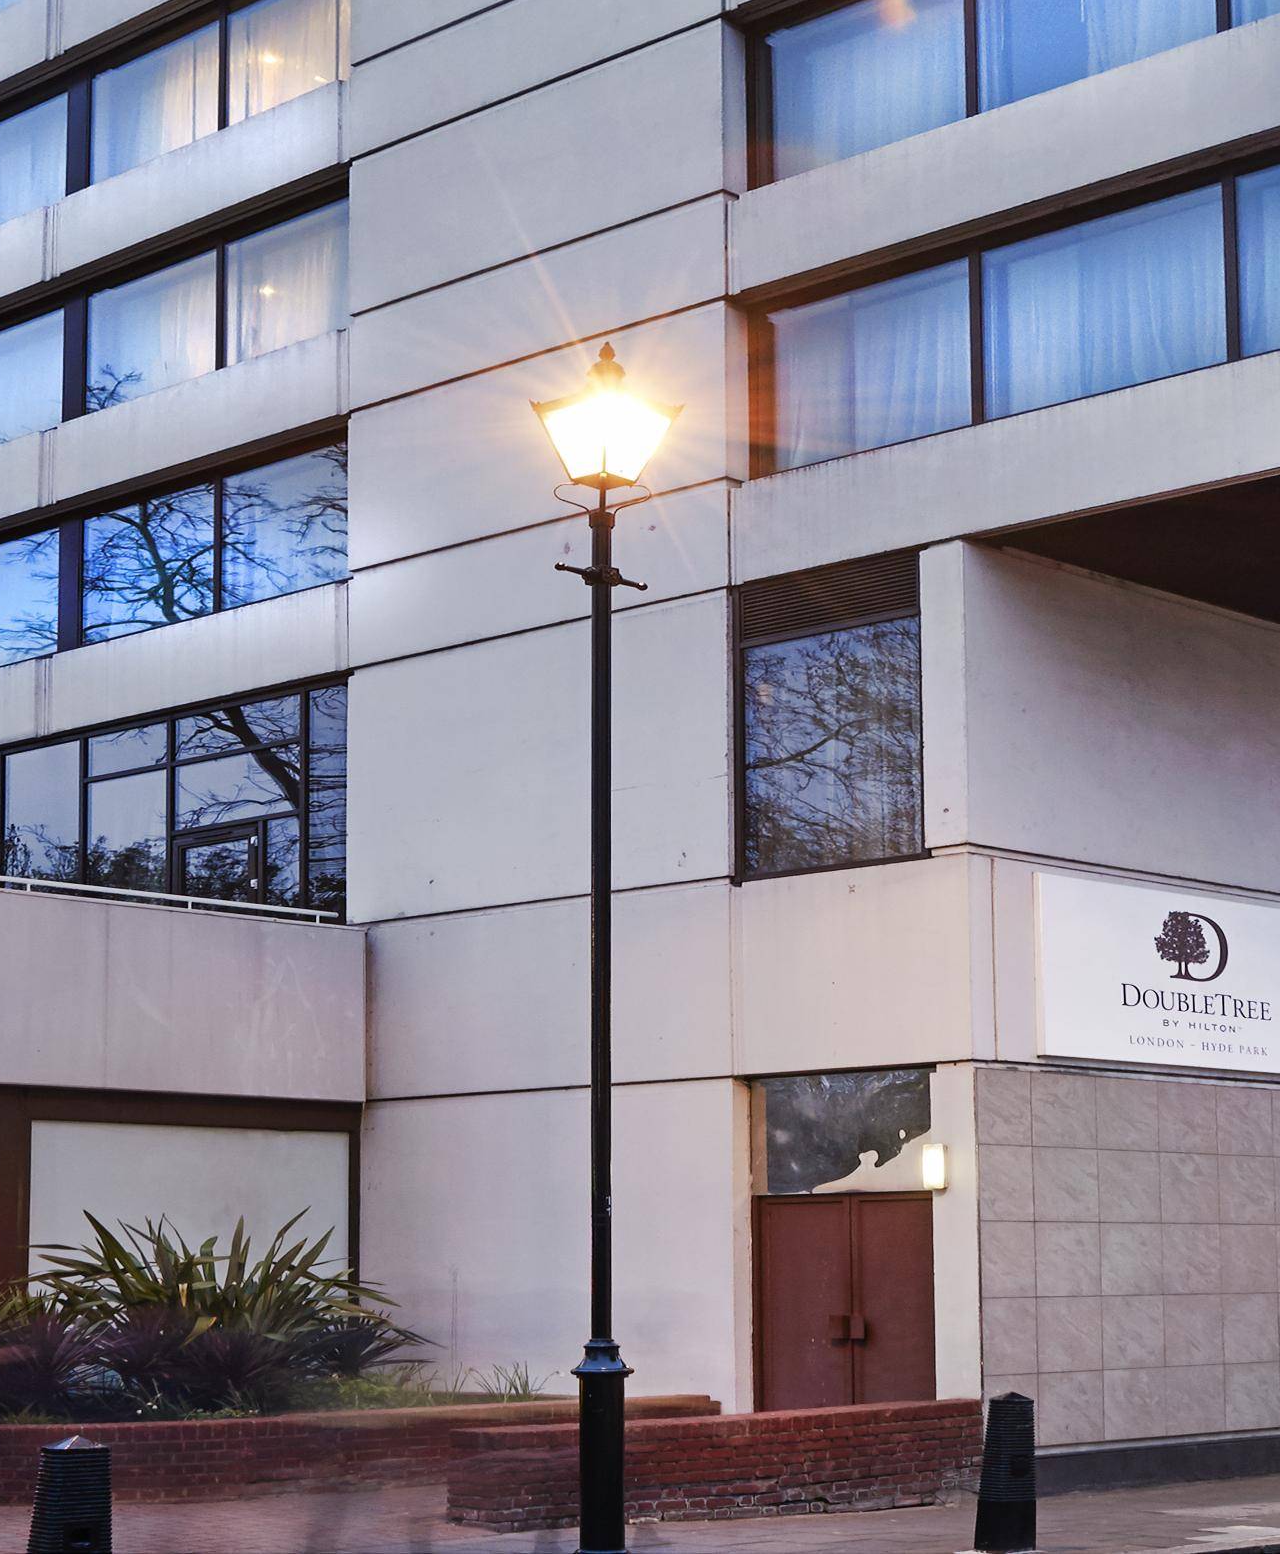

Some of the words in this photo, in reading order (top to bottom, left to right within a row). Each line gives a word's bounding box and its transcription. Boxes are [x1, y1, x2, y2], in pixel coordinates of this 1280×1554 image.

[1121, 983, 1272, 1022] DOUBLETREE
[1162, 1019, 1179, 1027] BY
[1188, 1022, 1236, 1033] HILTON
[1129, 1035, 1184, 1048] LONDON
[1201, 1042, 1233, 1053] HYDE
[1239, 1045, 1268, 1056] PARK
